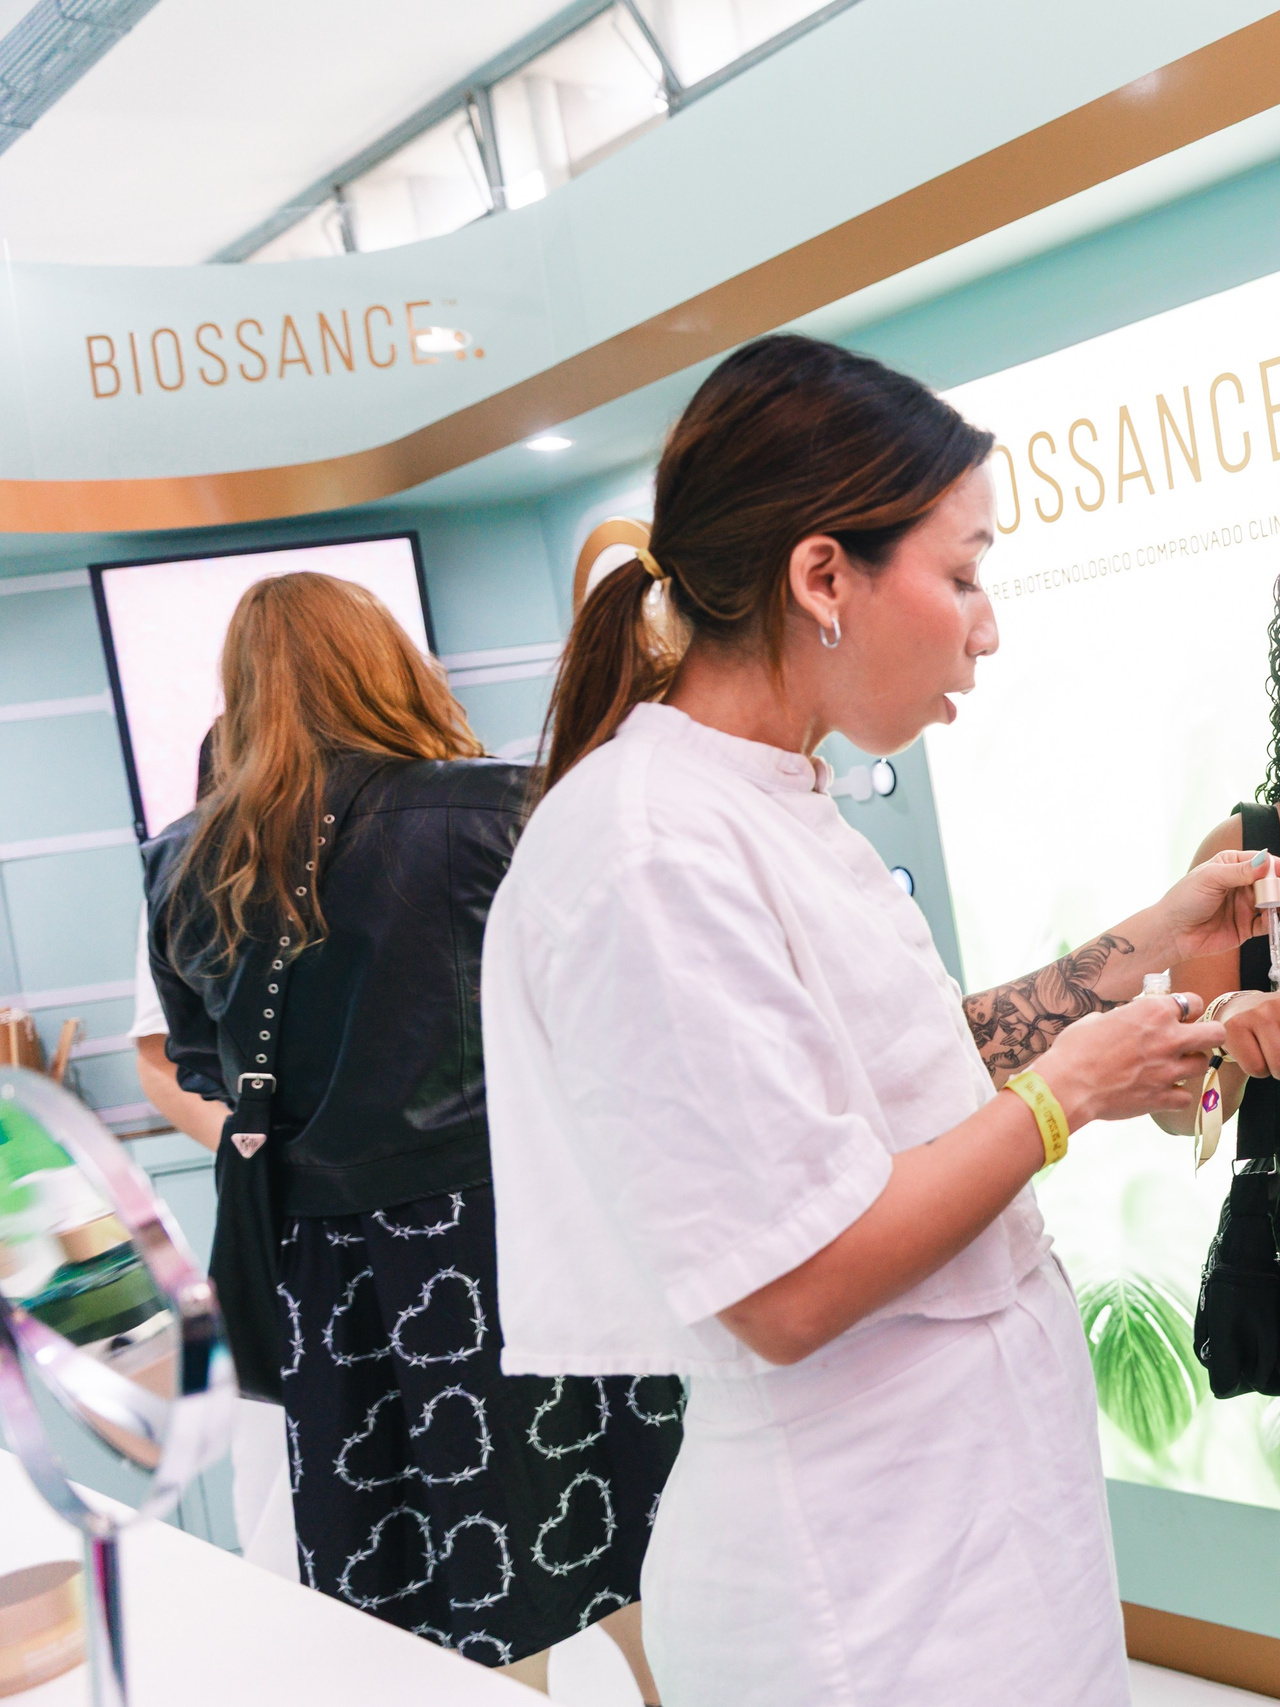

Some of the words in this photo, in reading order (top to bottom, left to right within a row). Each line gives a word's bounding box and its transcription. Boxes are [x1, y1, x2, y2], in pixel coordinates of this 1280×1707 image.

[85, 300, 439, 399] BIOSSANCE
[1014, 552, 1132, 597] BIOTECNOLOGICO
[1136, 524, 1243, 567] COMPROVADO
